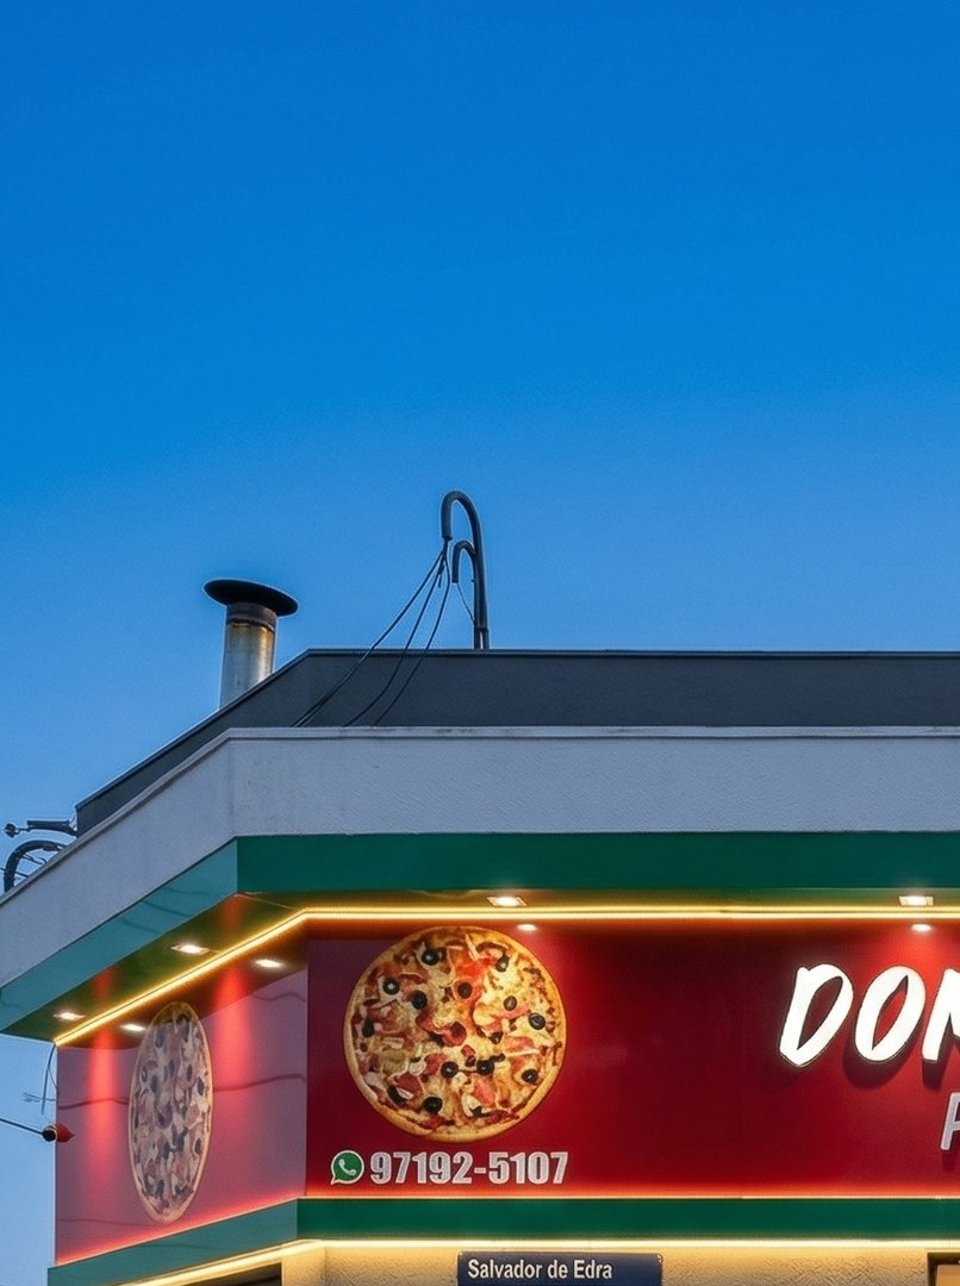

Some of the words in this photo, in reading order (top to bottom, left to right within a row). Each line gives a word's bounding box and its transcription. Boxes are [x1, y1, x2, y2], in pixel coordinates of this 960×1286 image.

[370, 1151, 569, 1185] 97192-5107
[467, 1258, 542, 1279] Salvador
[547, 1259, 569, 1279] de
[573, 1259, 613, 1279] Edra
